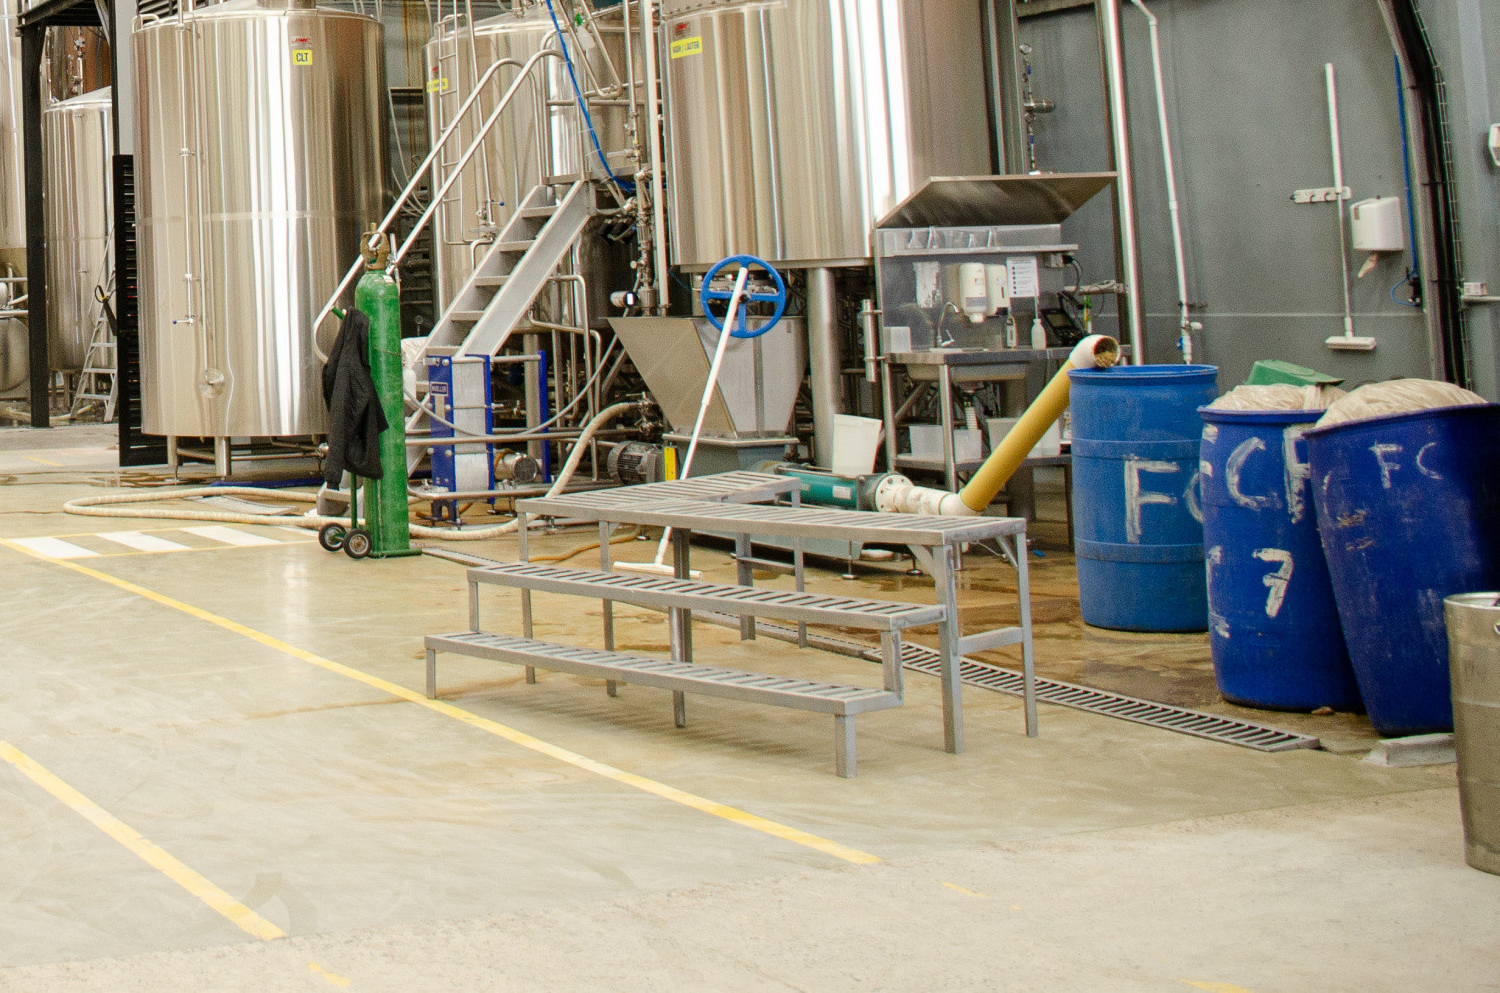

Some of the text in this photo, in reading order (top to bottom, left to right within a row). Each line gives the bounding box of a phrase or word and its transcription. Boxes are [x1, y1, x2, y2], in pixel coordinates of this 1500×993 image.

[296, 52, 309, 62] CLT
[1368, 439, 1444, 489] FC
[1252, 547, 1295, 619] 7
